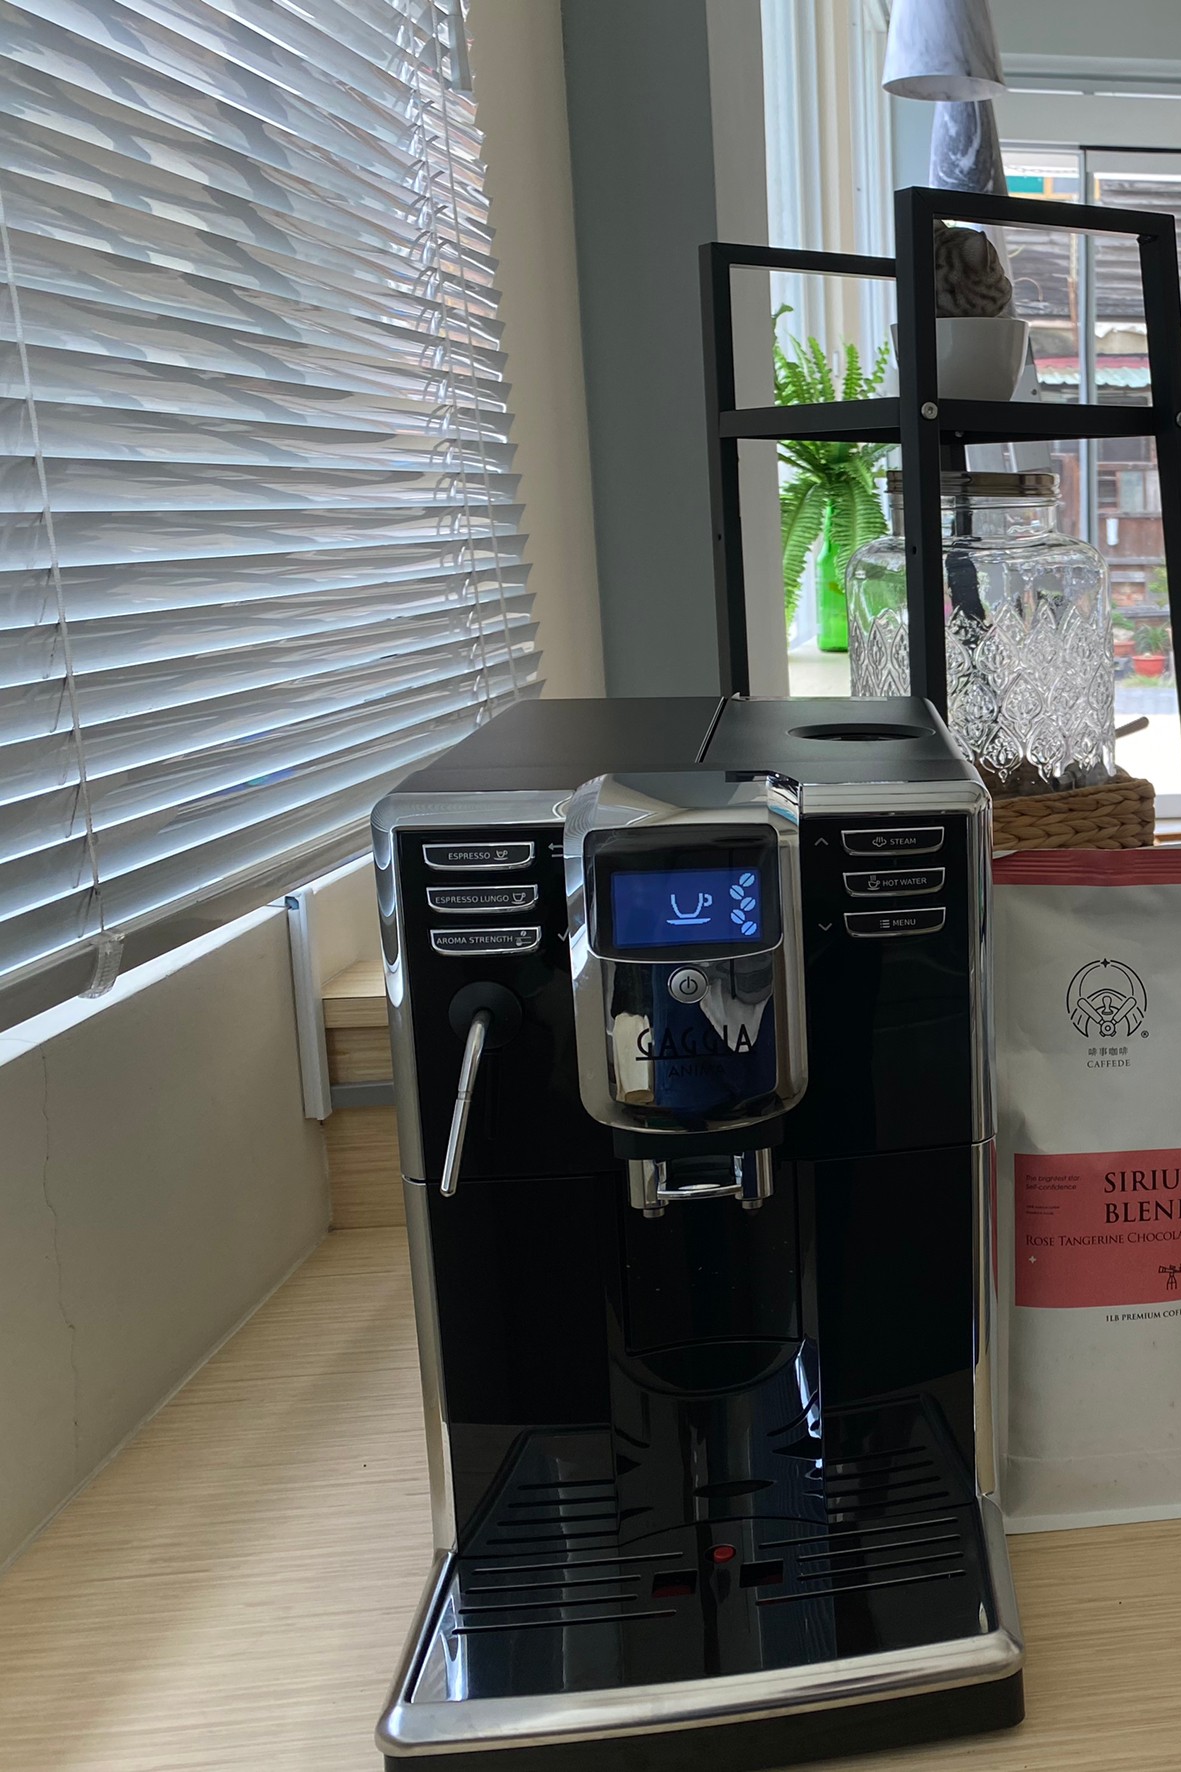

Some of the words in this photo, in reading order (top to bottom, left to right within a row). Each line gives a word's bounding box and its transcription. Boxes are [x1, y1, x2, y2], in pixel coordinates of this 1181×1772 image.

[890, 837, 917, 846] STEAM
[448, 852, 491, 861] ESPRESSO
[882, 879, 898, 887] HOT
[900, 877, 927, 886] WATER
[435, 896, 479, 904] ESPRESSO
[480, 894, 510, 903] LUNGO
[892, 918, 916, 927] MENU
[436, 937, 467, 945] AROMA
[469, 935, 513, 944] STRENGTH
[637, 1023, 757, 1059] GAGGIA
[1087, 1059, 1131, 1069] CAFFEDE
[1026, 1234, 1055, 1247] ROSE
[1058, 1233, 1124, 1247] TANGERINE
[1106, 1314, 1120, 1322] 1LB
[1121, 1311, 1161, 1321] PREMIUM
